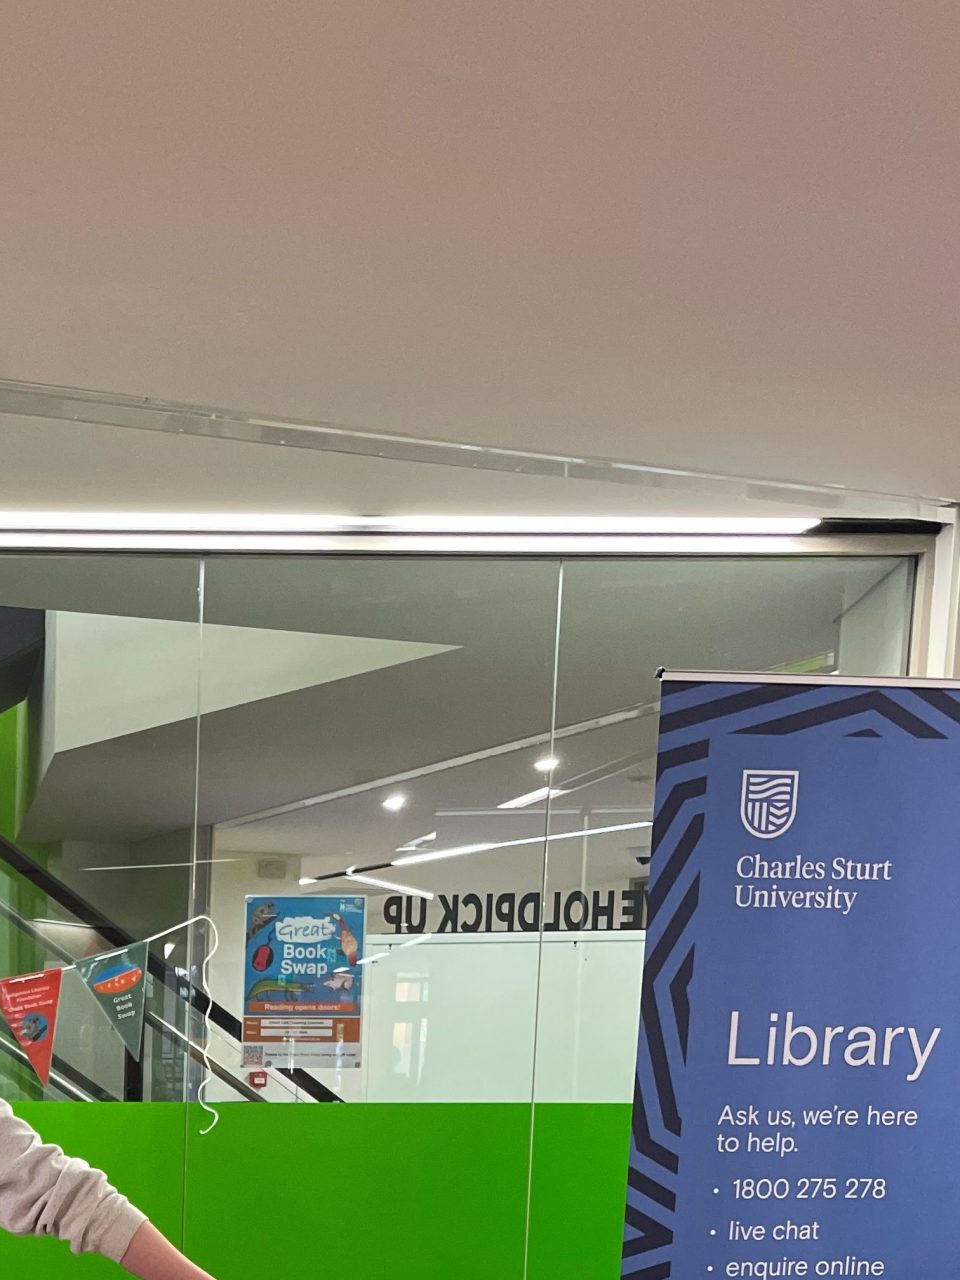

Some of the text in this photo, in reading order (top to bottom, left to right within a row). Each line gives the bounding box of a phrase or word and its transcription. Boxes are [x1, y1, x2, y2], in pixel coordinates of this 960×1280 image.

[736, 855, 892, 881] Charles Sturt
[735, 884, 858, 915] University
[278, 923, 330, 938] Great
[283, 944, 327, 959] Book
[281, 962, 328, 977] Swap
[113, 994, 132, 1003] Great
[116, 1002, 133, 1011] Book
[264, 1004, 294, 1013] Reading
[294, 1004, 317, 1012] opens
[118, 1010, 136, 1020] Swap
[727, 1011, 941, 1081] Library
[717, 1105, 918, 1128] Ask us, we're here
[716, 1132, 799, 1157] to help.
[733, 1178, 886, 1199] 1800 275 278
[728, 1220, 820, 1241] live chat
[725, 1256, 885, 1280] enquire online
